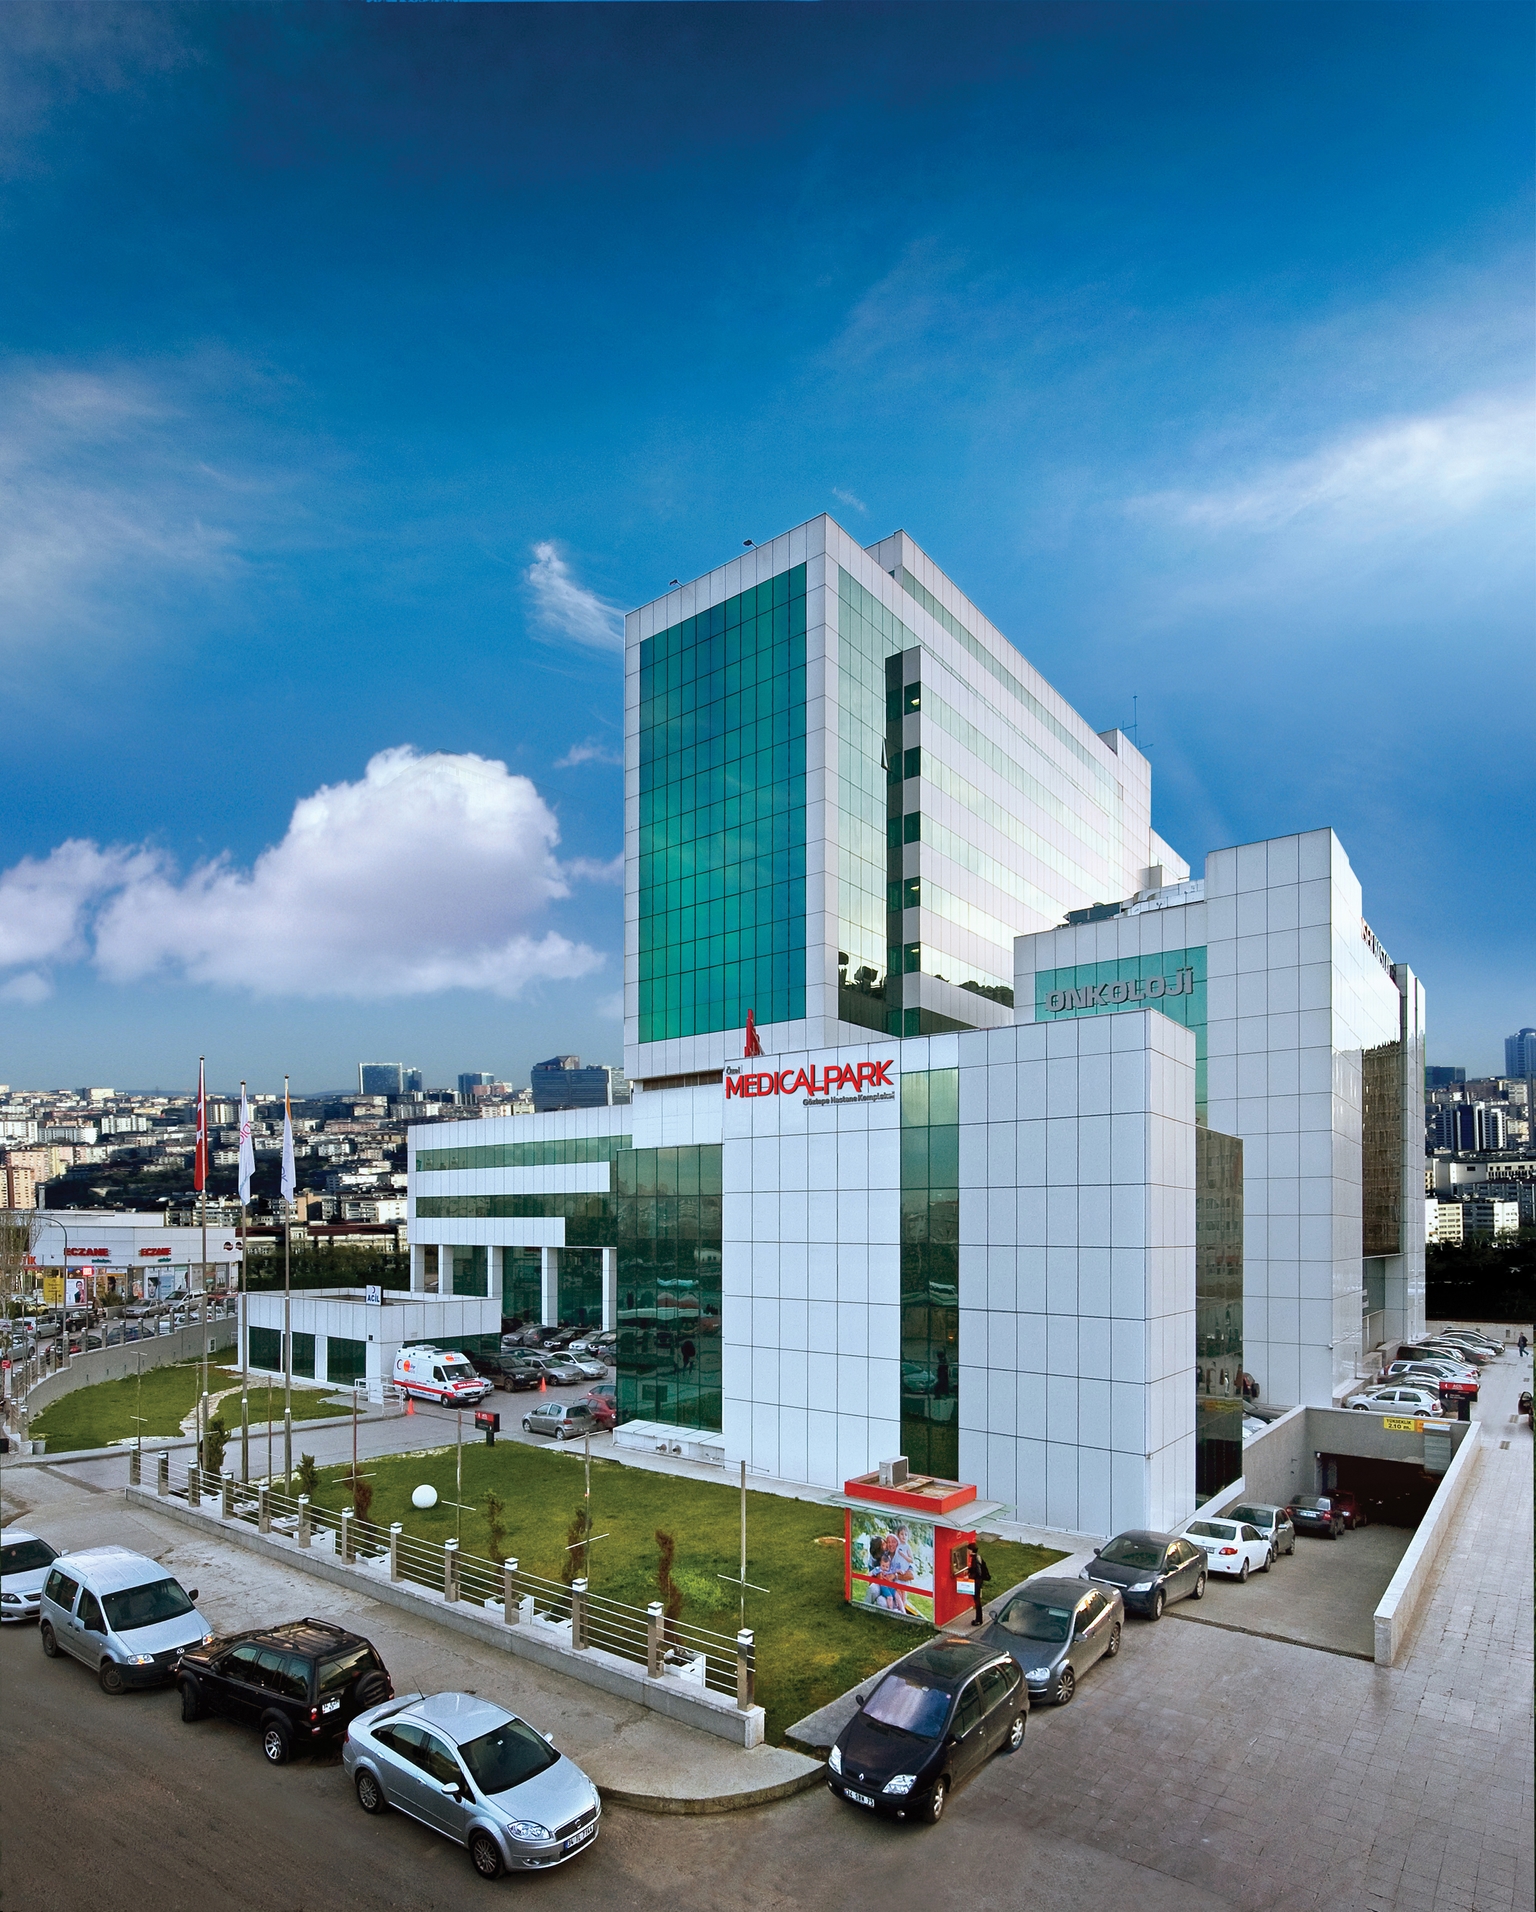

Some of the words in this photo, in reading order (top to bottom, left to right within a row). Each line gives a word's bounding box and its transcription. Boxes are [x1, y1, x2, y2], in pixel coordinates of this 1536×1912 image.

[831, 1095, 858, 1104] Hastane
[64, 1248, 110, 1257] ECZANE
[139, 1247, 172, 1257] ECZANE
